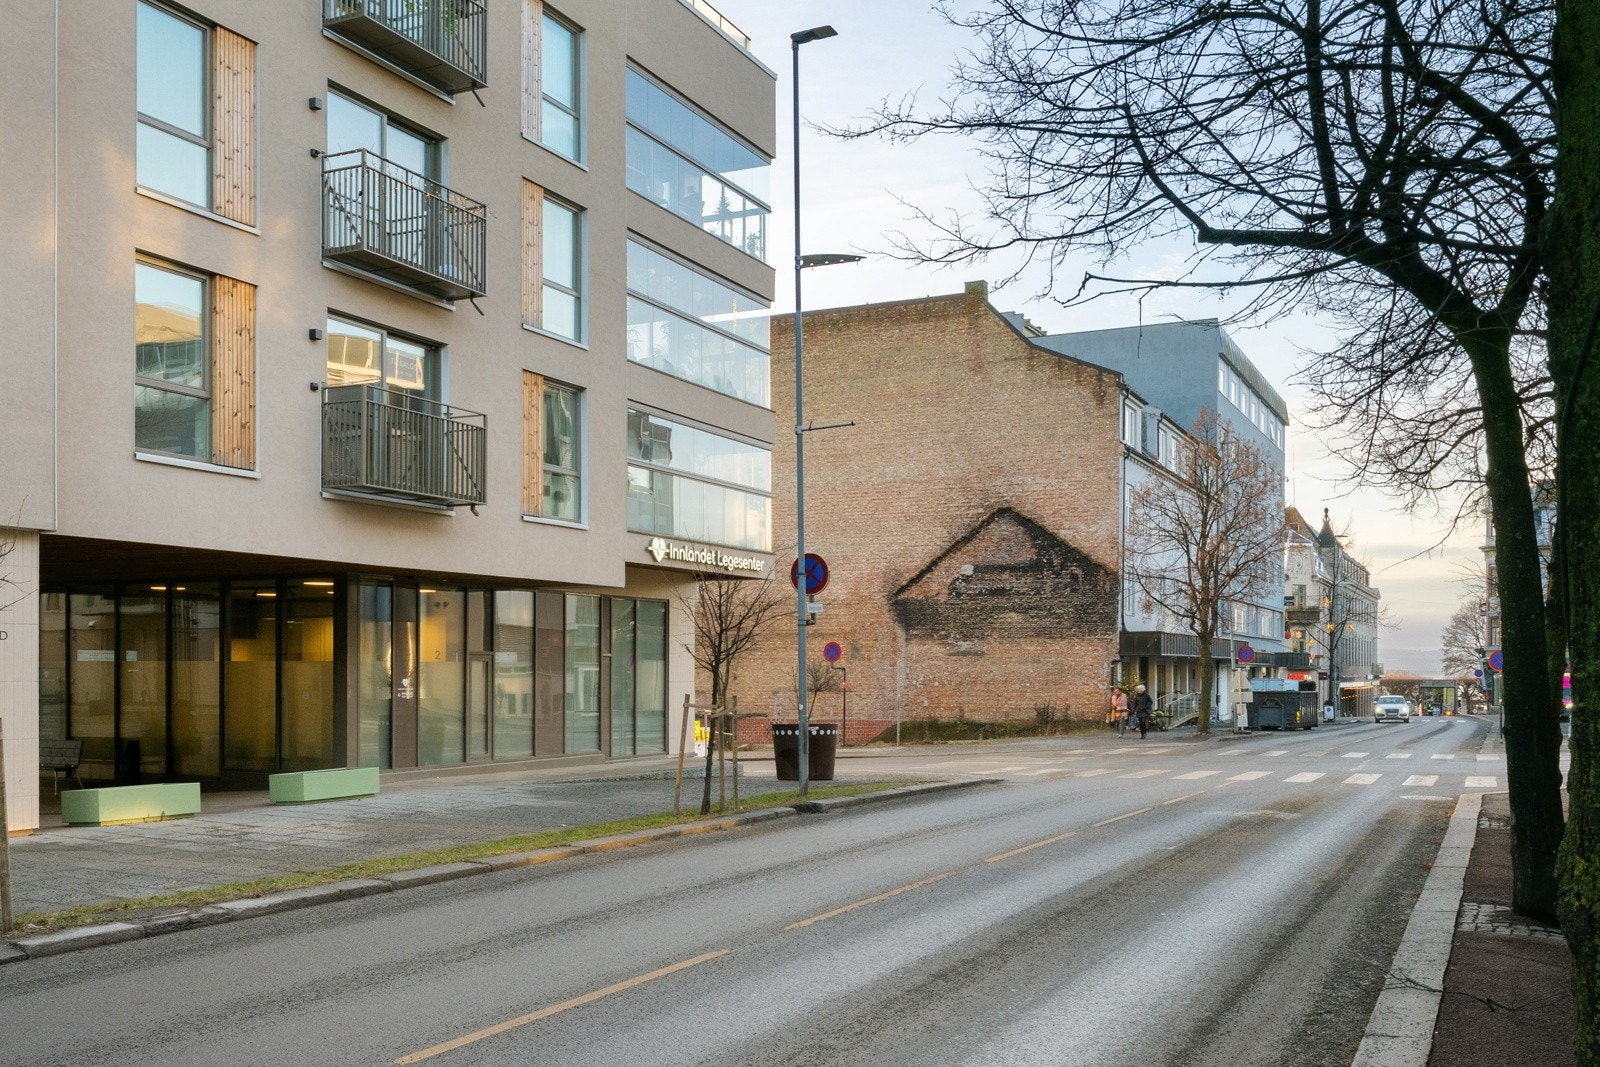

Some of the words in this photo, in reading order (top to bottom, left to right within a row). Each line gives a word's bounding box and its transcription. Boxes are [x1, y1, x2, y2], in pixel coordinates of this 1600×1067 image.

[669, 543, 716, 564] Innlandet
[717, 551, 765, 571] Legesenter
[435, 650, 440, 659] 2
